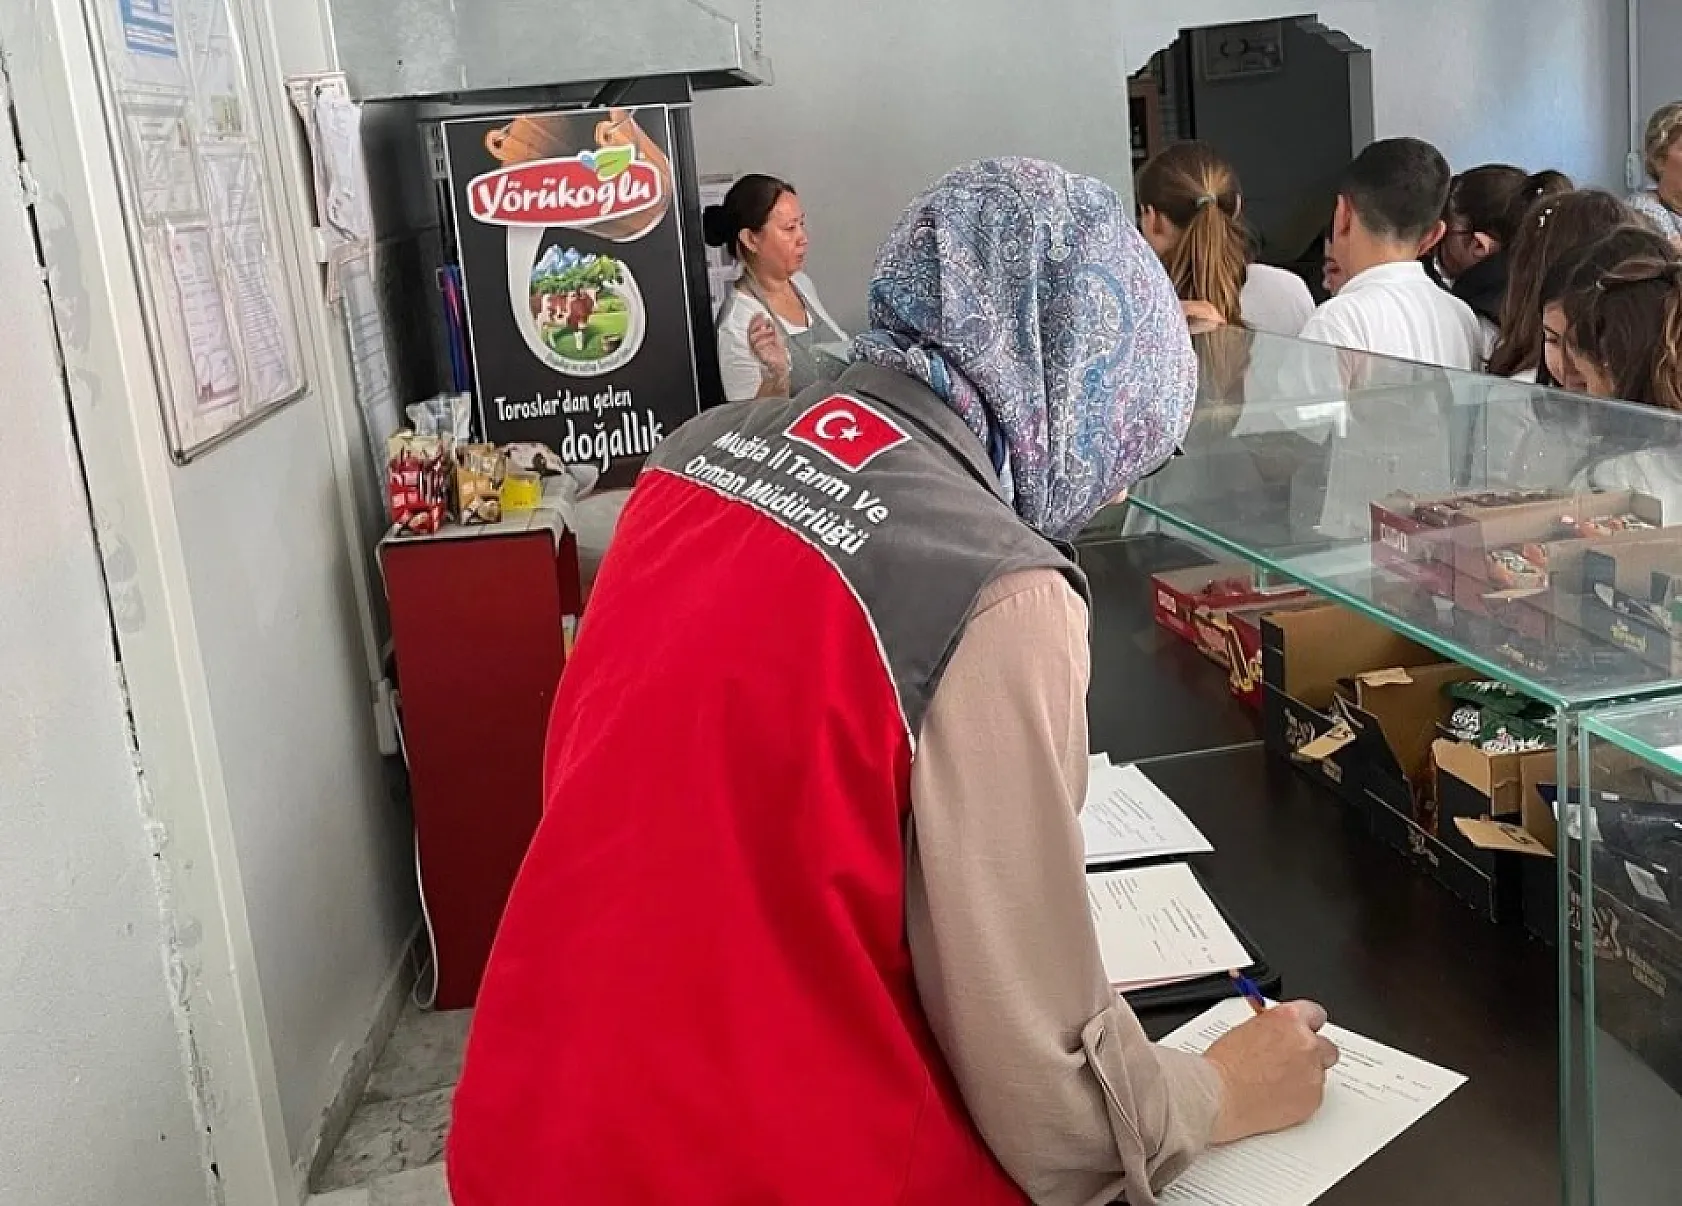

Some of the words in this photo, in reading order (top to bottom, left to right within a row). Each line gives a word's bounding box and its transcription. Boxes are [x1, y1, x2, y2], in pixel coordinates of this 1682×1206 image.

[494, 390, 590, 421] Toroslar'dan
[594, 385, 632, 417] gelen
[561, 409, 664, 473] doğallık
[684, 454, 748, 493] Orman
[743, 478, 871, 555] Müdürlüğü
[712, 431, 771, 462] Muğla
[785, 455, 851, 502] Tarım
[852, 490, 889, 524] Ve
